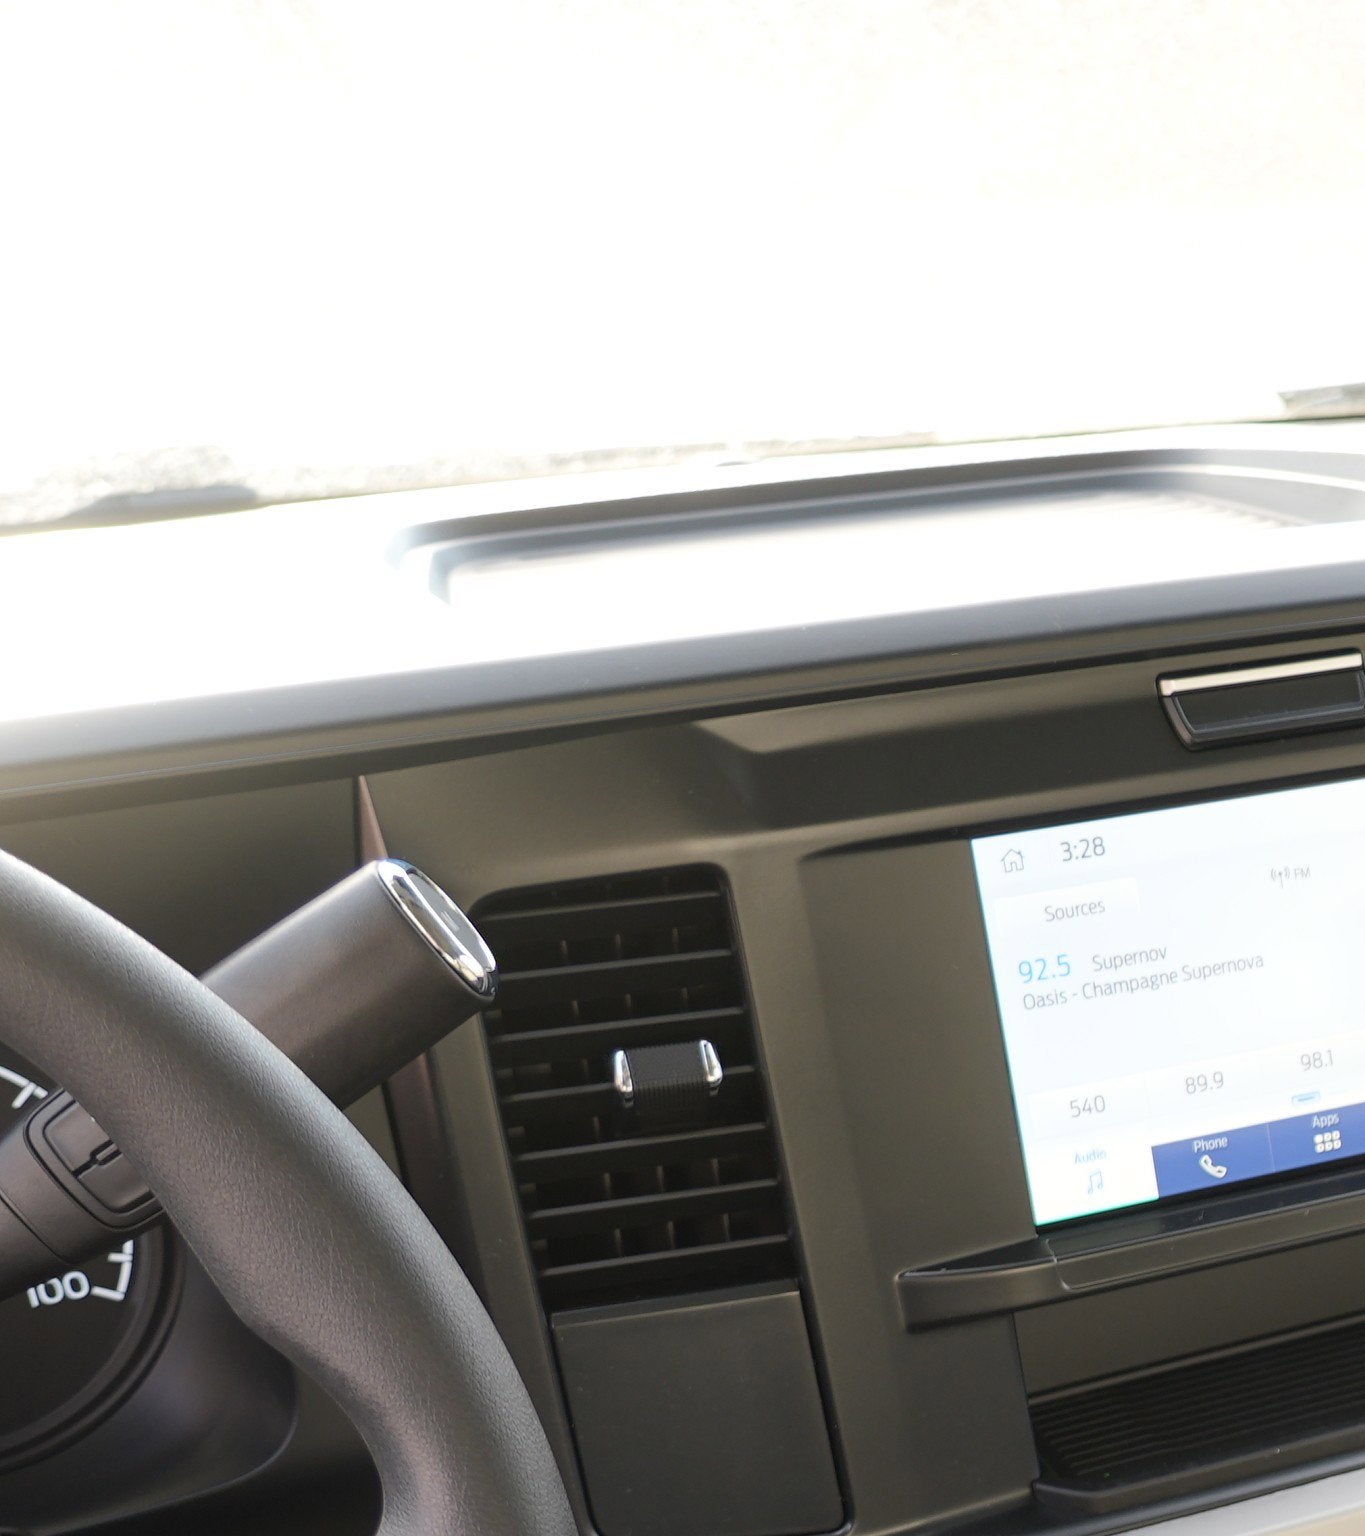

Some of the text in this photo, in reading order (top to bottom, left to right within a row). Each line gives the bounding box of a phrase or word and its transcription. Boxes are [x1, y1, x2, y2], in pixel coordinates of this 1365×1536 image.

[1060, 836, 1106, 862] 3:28
[1294, 866, 1311, 880] FM
[1044, 900, 1106, 922] Sources
[1018, 947, 1167, 984] 92.5 Supernov
[1023, 989, 1068, 1010] Oasis
[1082, 969, 1178, 1000] Champagne
[1181, 954, 1264, 982] Supernova
[1070, 1094, 1106, 1118] 540
[1185, 1071, 1224, 1094] 89.9
[1300, 1049, 1334, 1071] 98.1
[1311, 1112, 1339, 1129] Apps
[1193, 1135, 1228, 1153] Phone
[1074, 1149, 1107, 1164] Audio
[27, 1270, 90, 1309] 100
